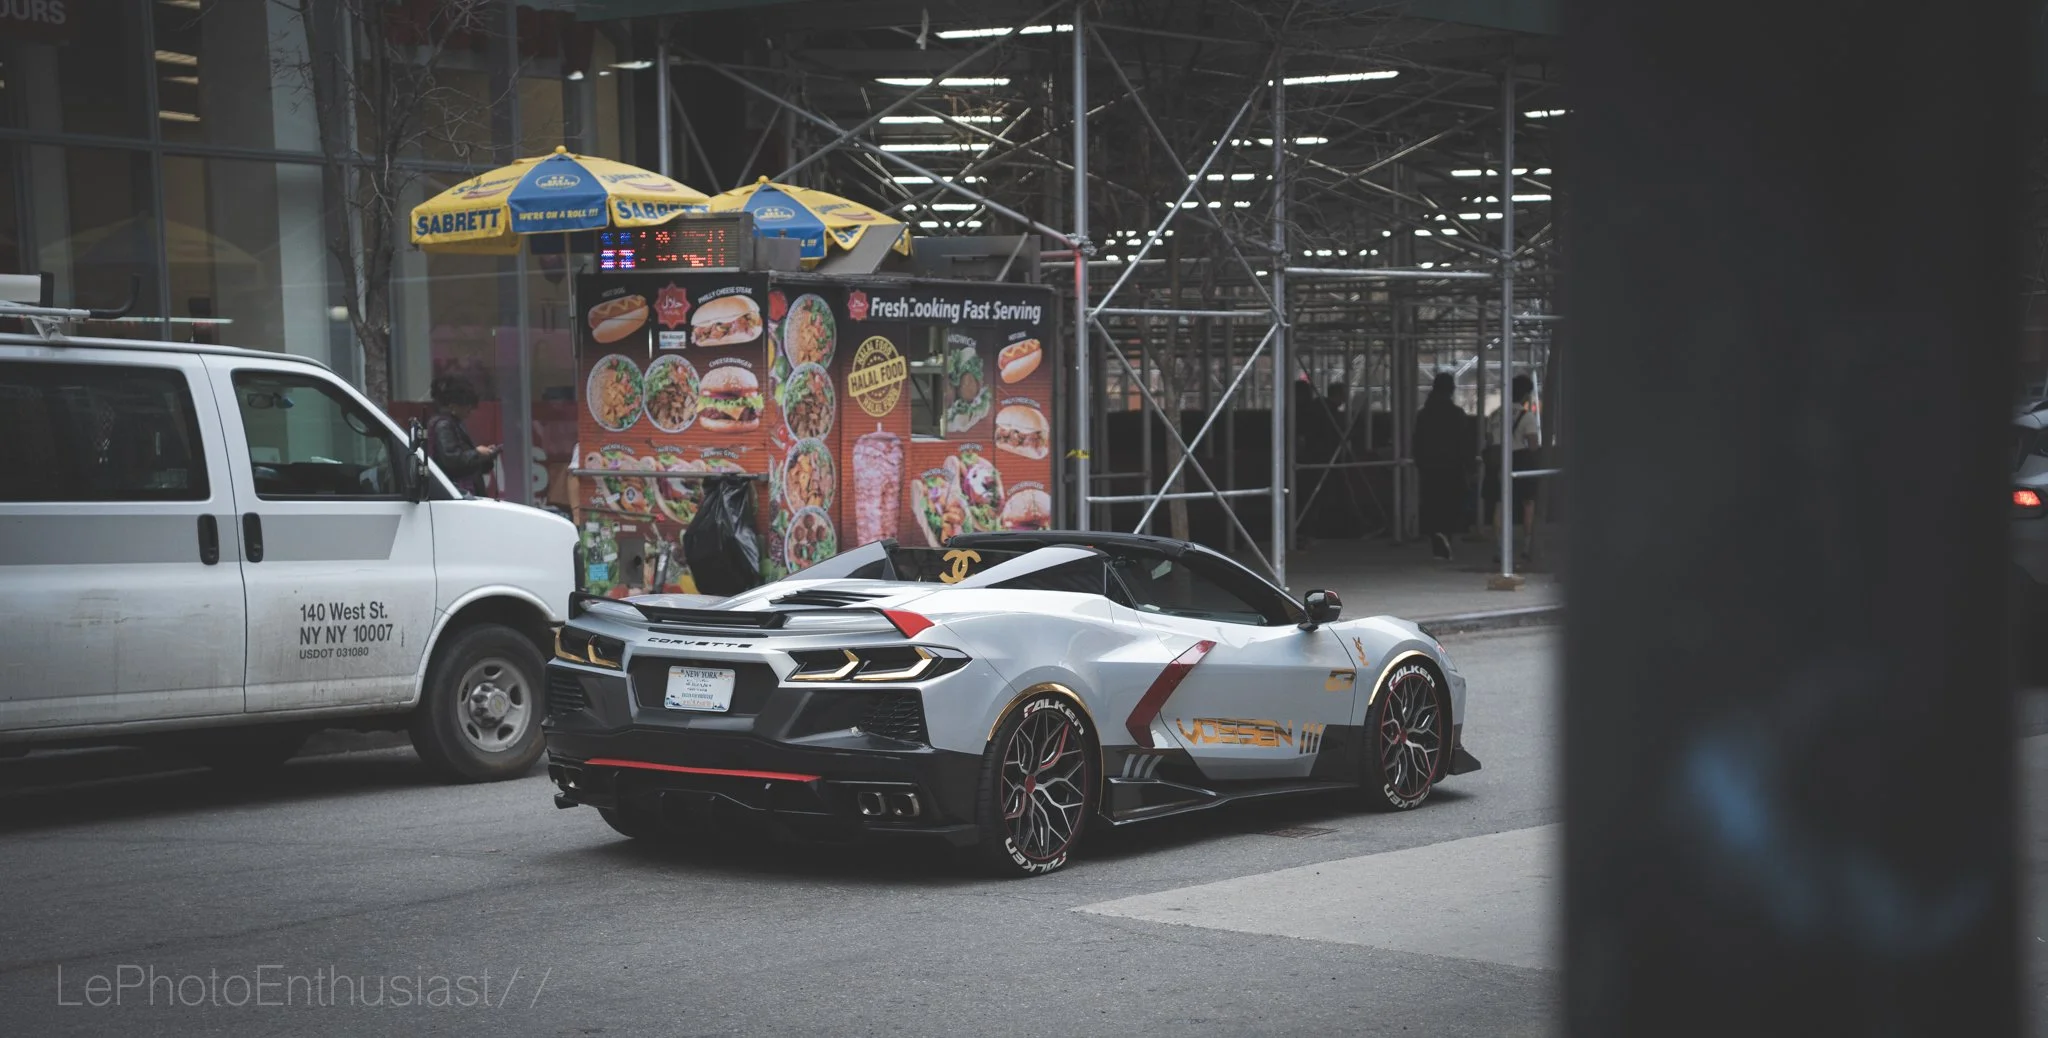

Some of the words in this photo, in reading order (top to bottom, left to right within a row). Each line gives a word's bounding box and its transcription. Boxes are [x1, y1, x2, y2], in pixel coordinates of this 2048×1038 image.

[416, 208, 501, 236] SABRETT
[519, 211, 544, 220] WE'RE
[546, 210, 558, 219] ON
[560, 210, 565, 218] A
[567, 209, 586, 218] ROLL
[697, 290, 716, 304] PHILLY
[716, 287, 736, 296] CHEESE
[736, 286, 752, 294] STEAK
[871, 297, 909, 318] Fresh
[963, 300, 989, 320] Fast
[993, 300, 1041, 325] Serving
[708, 356, 753, 369] CHEESEBURGER
[850, 369, 879, 393] HALAL
[880, 361, 904, 383] FOOD
[300, 603, 325, 621] 140
[329, 602, 366, 621] West
[370, 601, 388, 619] St.
[300, 626, 321, 645] NY
[326, 625, 347, 644] NY
[353, 623, 393, 643] 10007
[648, 637, 753, 648] CORVETTE
[299, 648, 334, 659] USDOT
[336, 646, 369, 658] 031080
[684, 669, 700, 679] NEW
[701, 671, 718, 680] YORK
[1387, 665, 1436, 692] FALKEN
[1023, 698, 1085, 736] FALKEN
[1176, 717, 1293, 748] VOSSEN
[1005, 836, 1067, 874] FALKEN
